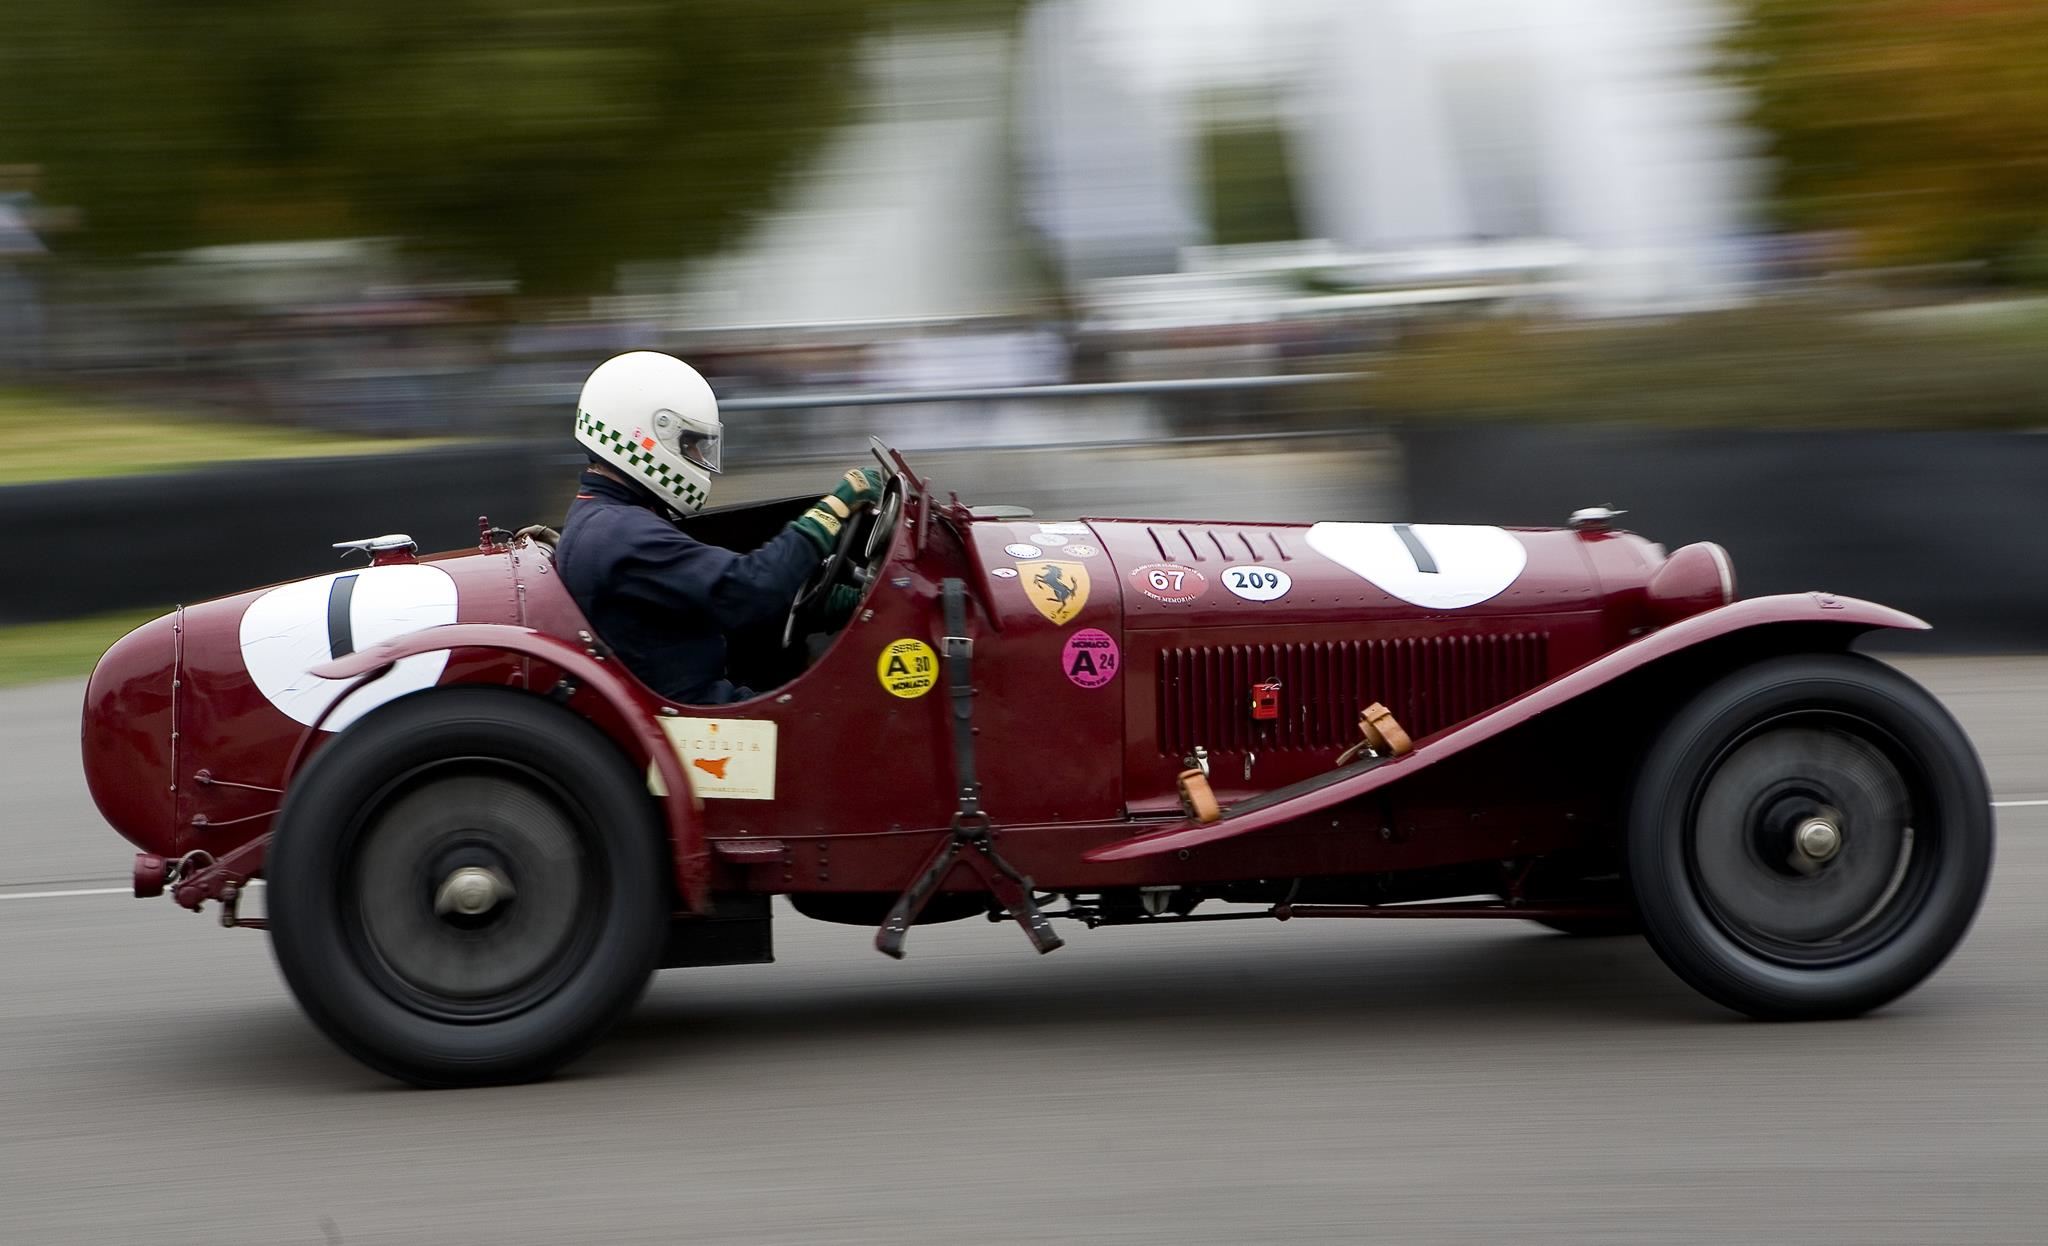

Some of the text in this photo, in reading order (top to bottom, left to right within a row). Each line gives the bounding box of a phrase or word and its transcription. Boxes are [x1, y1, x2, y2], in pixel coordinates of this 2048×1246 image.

[1148, 569, 1185, 591] 67
[1232, 572, 1279, 589] 209
[1162, 594, 1196, 603] MEMORIAL
[892, 642, 922, 654] SERIE
[1071, 641, 1110, 649] MONACO
[886, 655, 931, 677] A 30
[1069, 650, 1115, 676] A 24
[892, 679, 931, 690] MONACO
